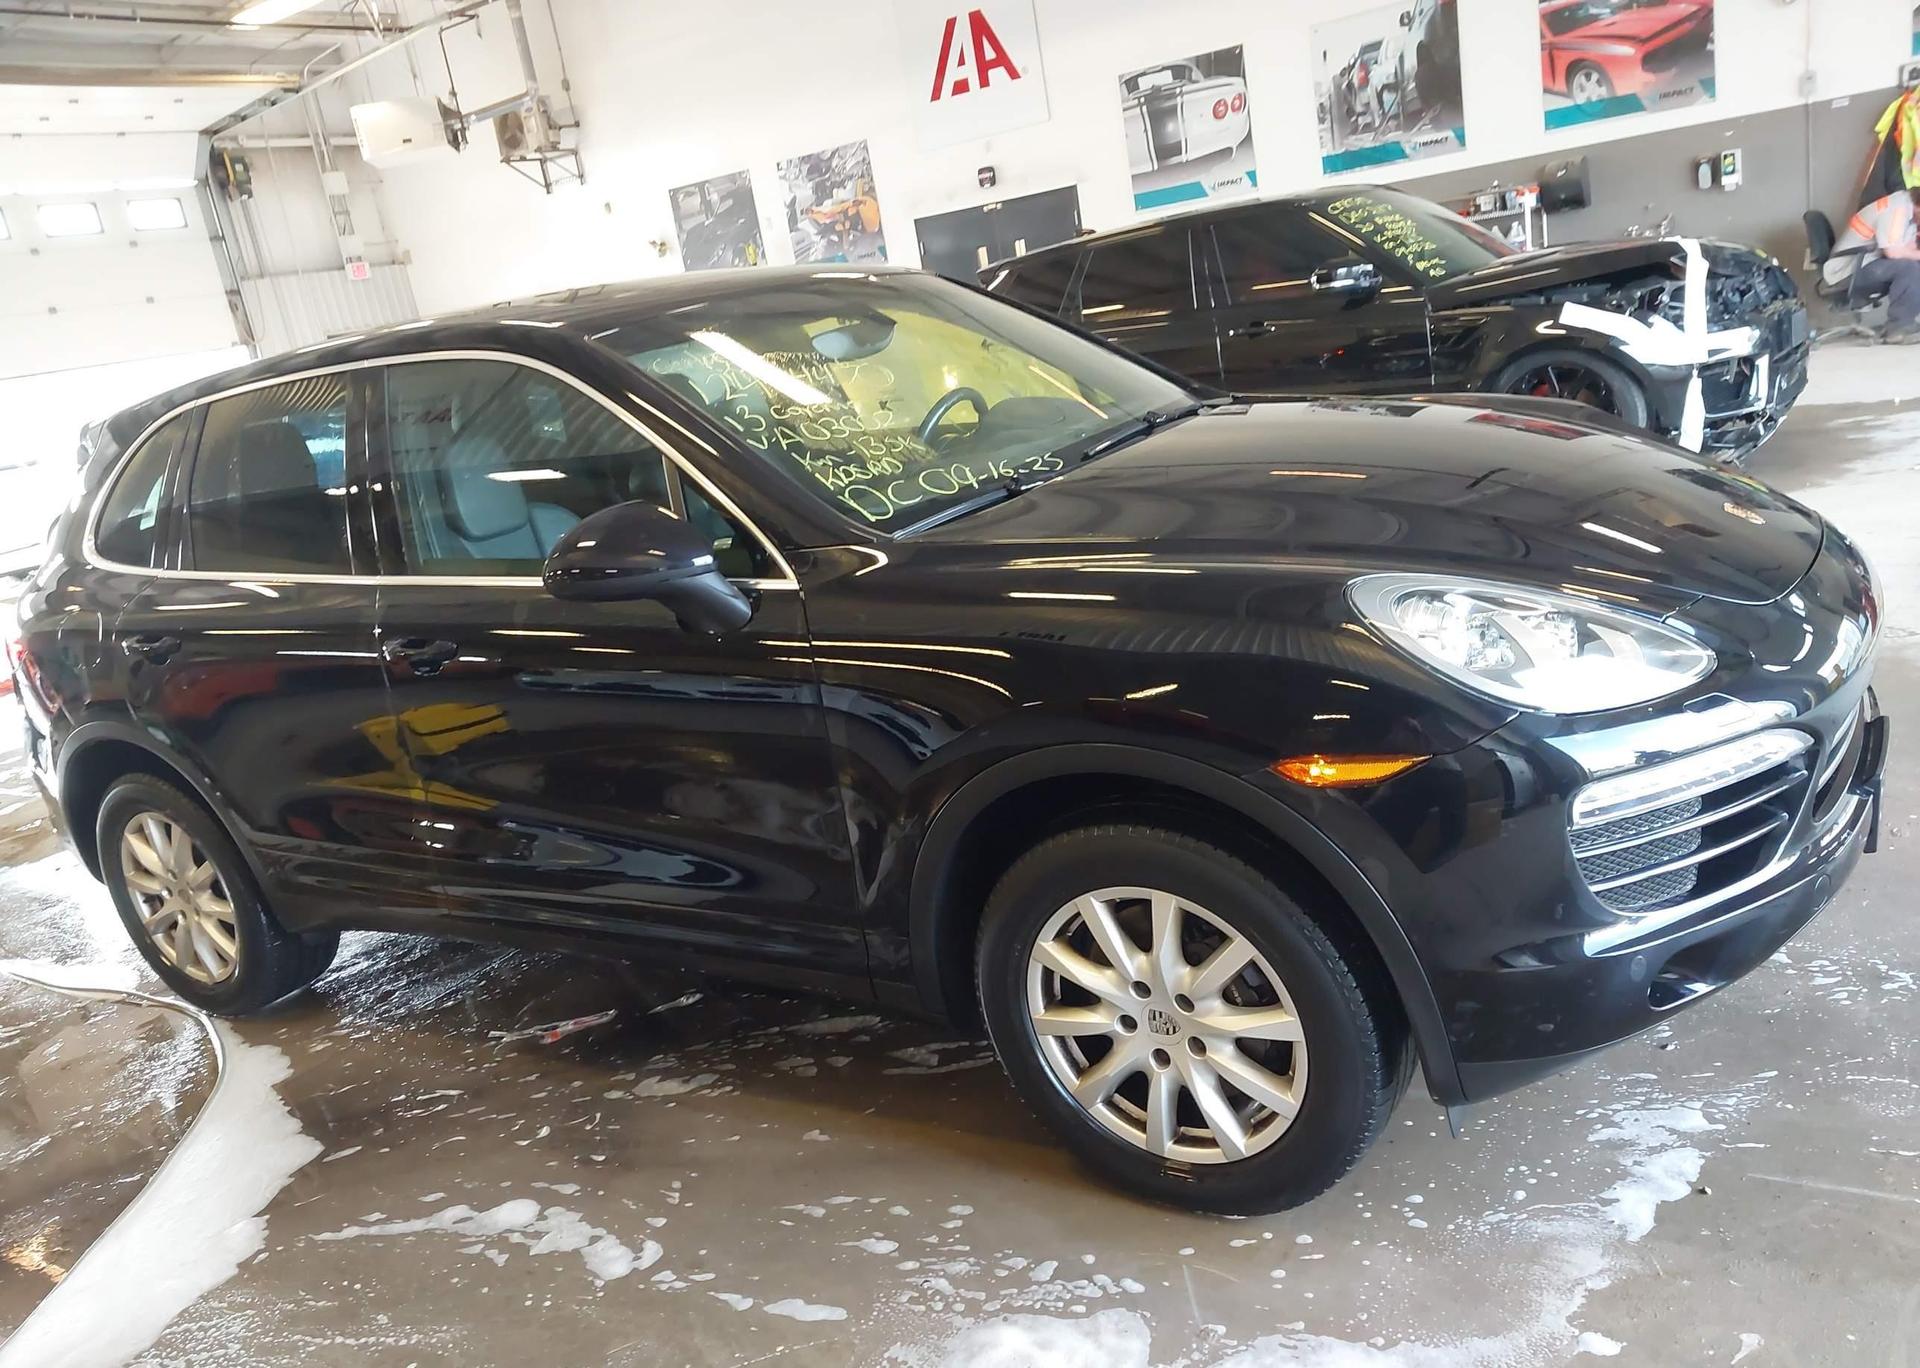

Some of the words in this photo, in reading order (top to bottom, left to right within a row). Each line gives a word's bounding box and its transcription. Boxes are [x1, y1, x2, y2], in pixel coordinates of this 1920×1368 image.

[1659, 88, 1693, 99] IMPACT
[1419, 137, 1448, 147] IMPACT
[1218, 177, 1242, 187] IMPACT
[723, 404, 767, 432] 13
